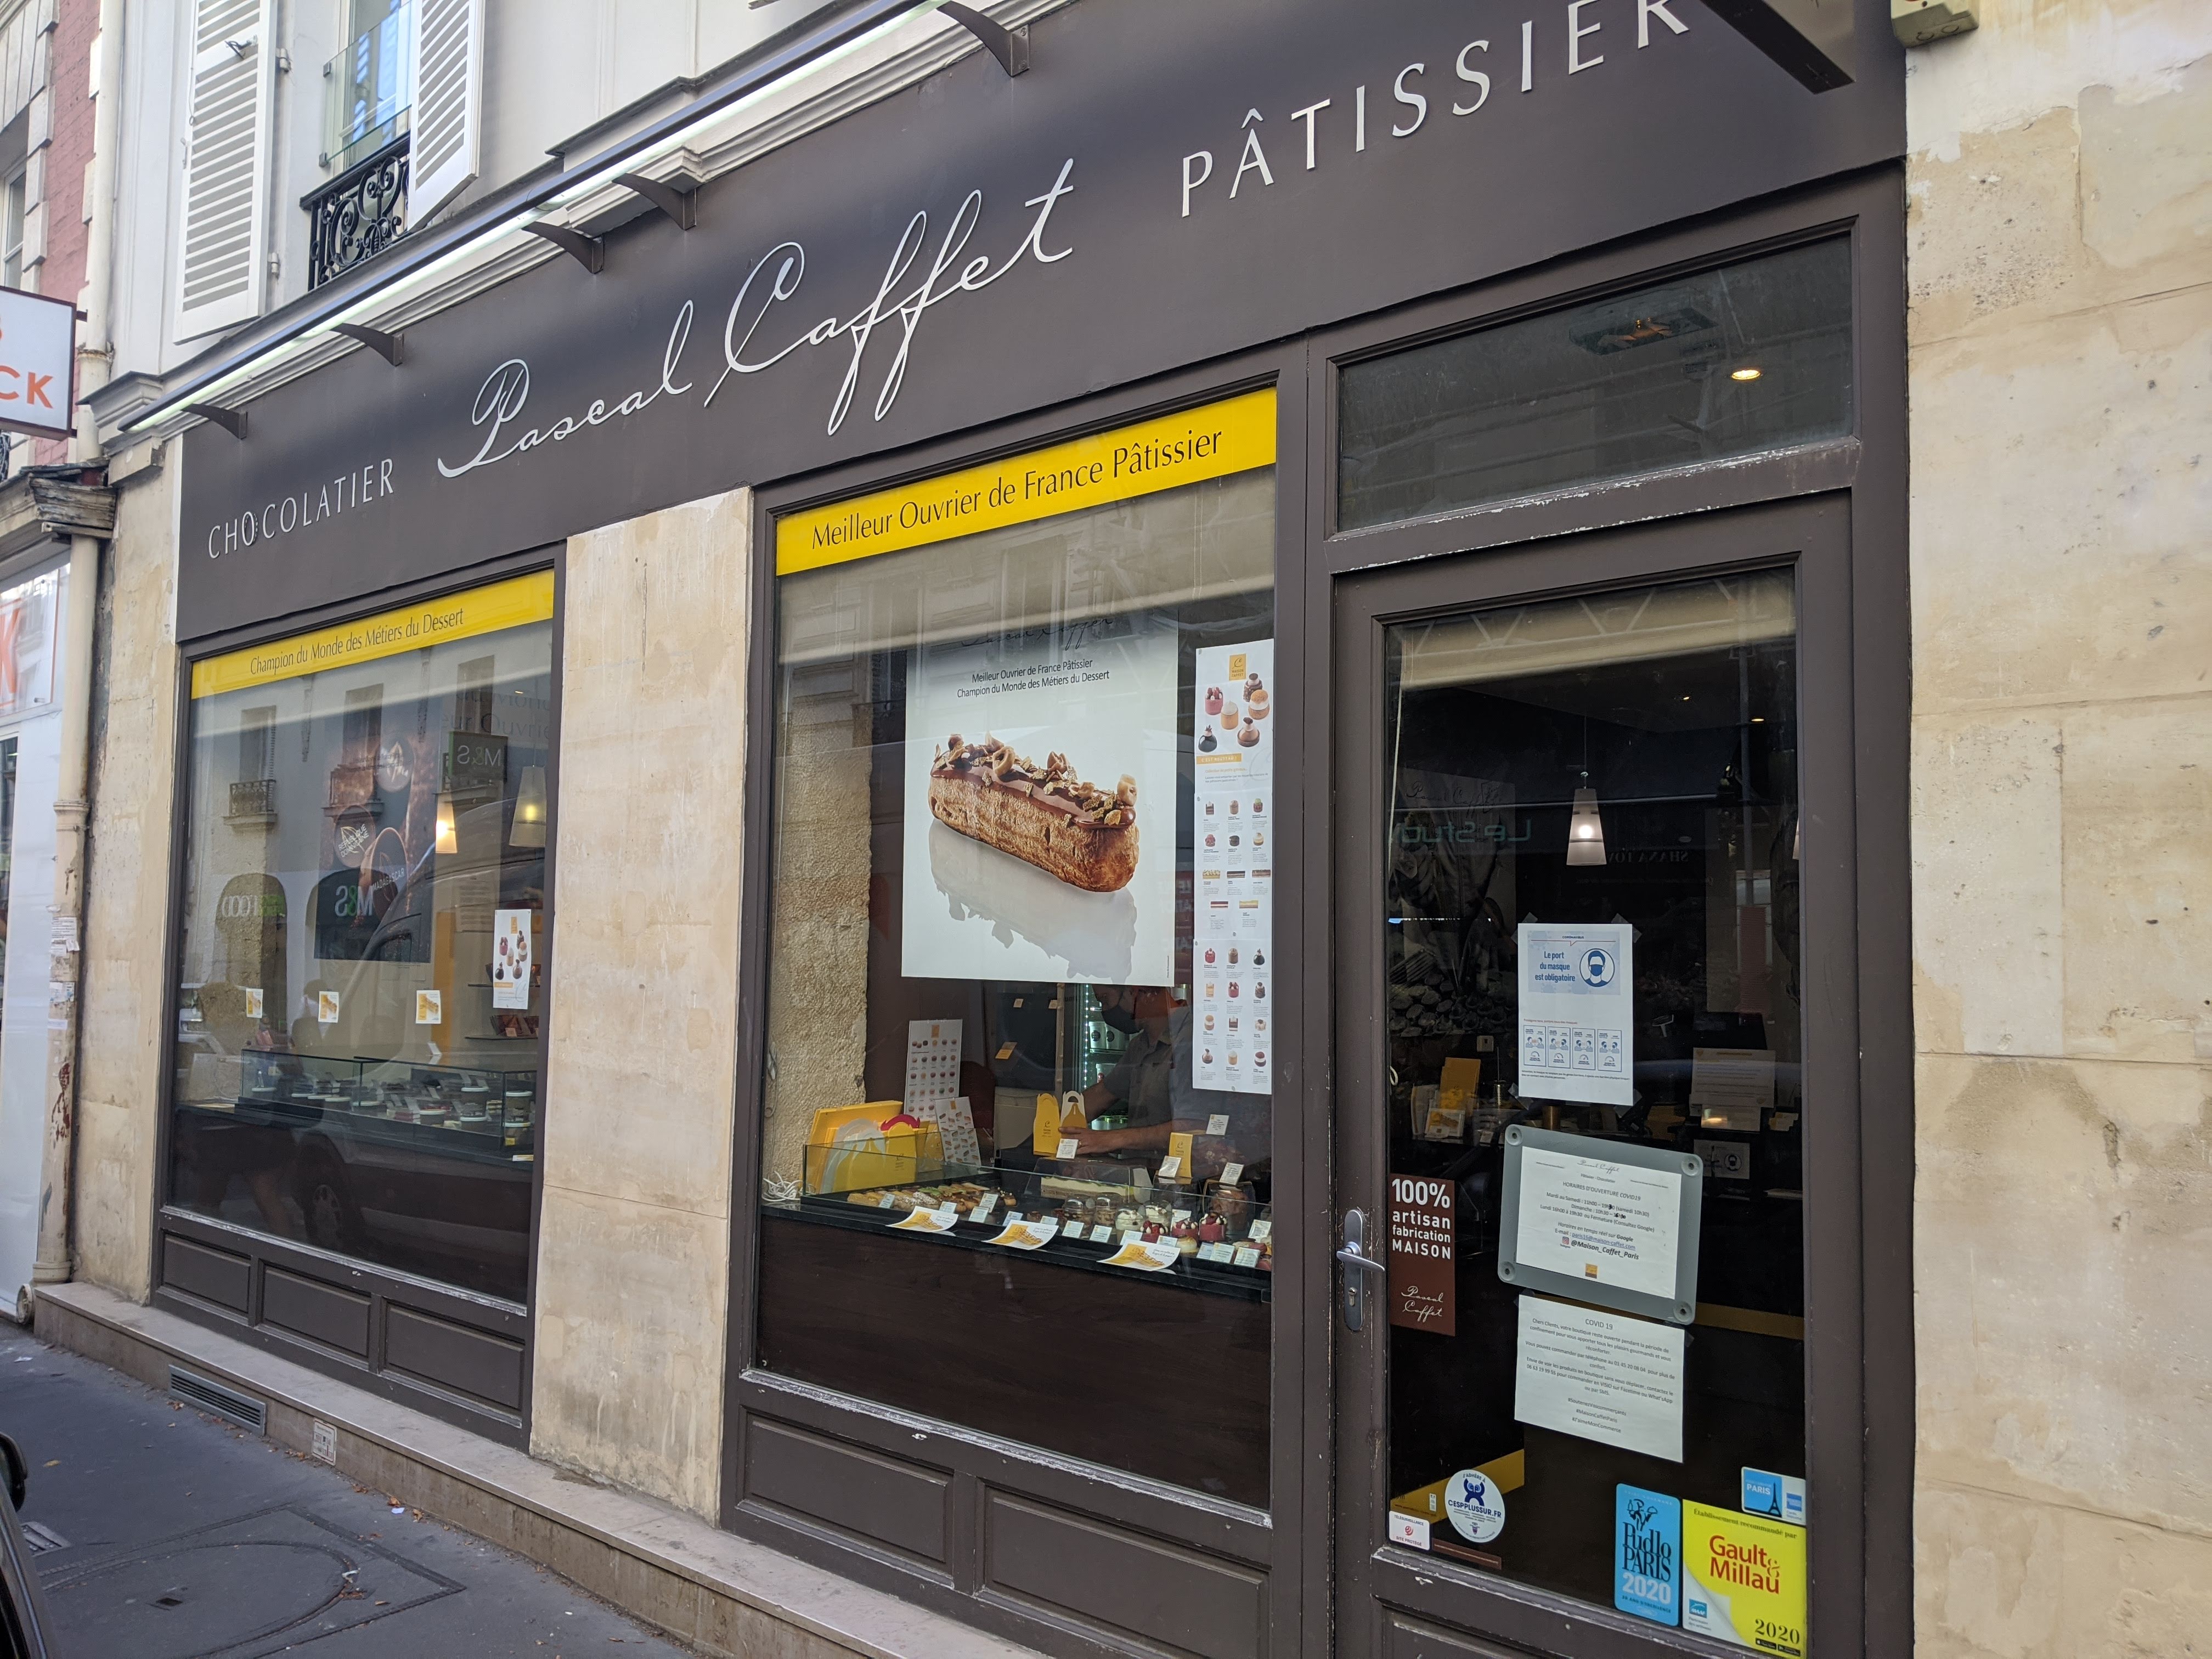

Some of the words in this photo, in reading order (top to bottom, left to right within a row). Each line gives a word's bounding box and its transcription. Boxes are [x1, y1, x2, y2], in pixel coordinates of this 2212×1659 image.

[437, 298, 695, 478] Pascal
[704, 157, 1074, 437] Caffet
[811, 514, 892, 550] Meilleur
[900, 489, 981, 528] Ouvrier
[989, 476, 1015, 507] de
[1025, 458, 1103, 500] France
[1113, 429, 1222, 477] Pâtissier
[208, 458, 394, 559] CHOCOLATIER
[250, 651, 293, 675] Champion
[297, 645, 307, 663] du
[311, 636, 343, 660] Monde
[346, 632, 362, 652] des
[365, 625, 402, 647] Métiers
[405, 617, 419, 637] du
[423, 608, 463, 634] Dessert
[972, 672, 999, 683] Meilleur
[1001, 668, 1026, 679] Ouvrier
[1028, 665, 1036, 675] de
[1038, 663, 1060, 674] France
[1063, 659, 1092, 670] Pâtissier
[957, 686, 990, 698] Champion
[992, 684, 1000, 693] du
[1002, 681, 1026, 692] Monde
[1028, 679, 1040, 689] des
[1042, 676, 1068, 687] Métiers
[1070, 674, 1080, 683] du
[1082, 670, 1109, 682] Dessert
[1548, 963, 1570, 972] masque
[1551, 951, 1564, 961] port
[1544, 973, 1575, 983] obligatoire
[1392, 1178, 1450, 1208] 100%
[1562, 1181, 1585, 1190] HORAIRES
[1586, 1186, 1618, 1197] D'OUVERTURE
[1620, 1192, 1640, 1201] COVID19
[1392, 1211, 1451, 1229] artisan
[1392, 1224, 1451, 1243] fabrication
[1616, 1234, 1633, 1243] Google
[1392, 1238, 1451, 1260] MAISON
[1571, 1239, 1639, 1261] @Maison_Caffet_Paris
[1401, 1286, 1443, 1302] Pascal
[1402, 1300, 1442, 1323] Caffet
[1584, 1318, 1604, 1328] COVID
[1747, 1483, 1770, 1495] PARIS
[1448, 1499, 1502, 1518] CESPPLUSSUR.FR
[1694, 1508, 1739, 1525] Établissement
[1741, 1520, 1782, 1536] recommandé
[1785, 1530, 1797, 1539] par
[1622, 1522, 1672, 1559] Pudlo
[1709, 1535, 1767, 1568] Gault
[1622, 1544, 1671, 1582] PARIS
[1710, 1556, 1779, 1595] Millau
[1622, 1572, 1671, 1605] 2020
[1755, 1619, 1799, 1644] 2020
